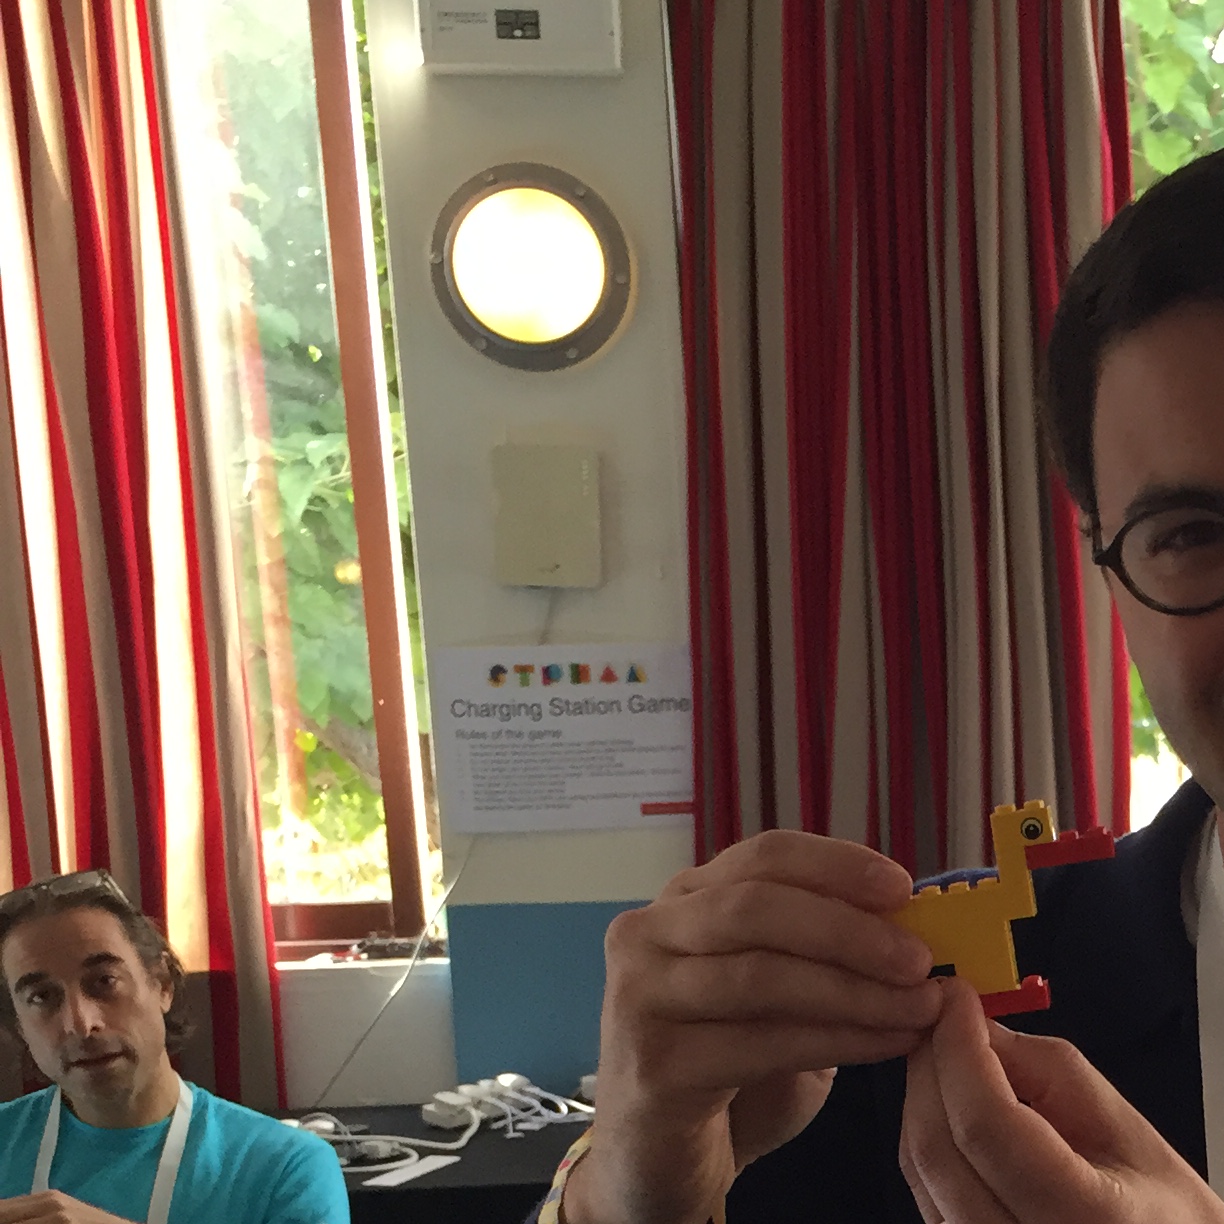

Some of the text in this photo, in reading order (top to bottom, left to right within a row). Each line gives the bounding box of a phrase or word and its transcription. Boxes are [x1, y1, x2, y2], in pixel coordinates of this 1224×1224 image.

[450, 693, 692, 722] Charging Station Game
